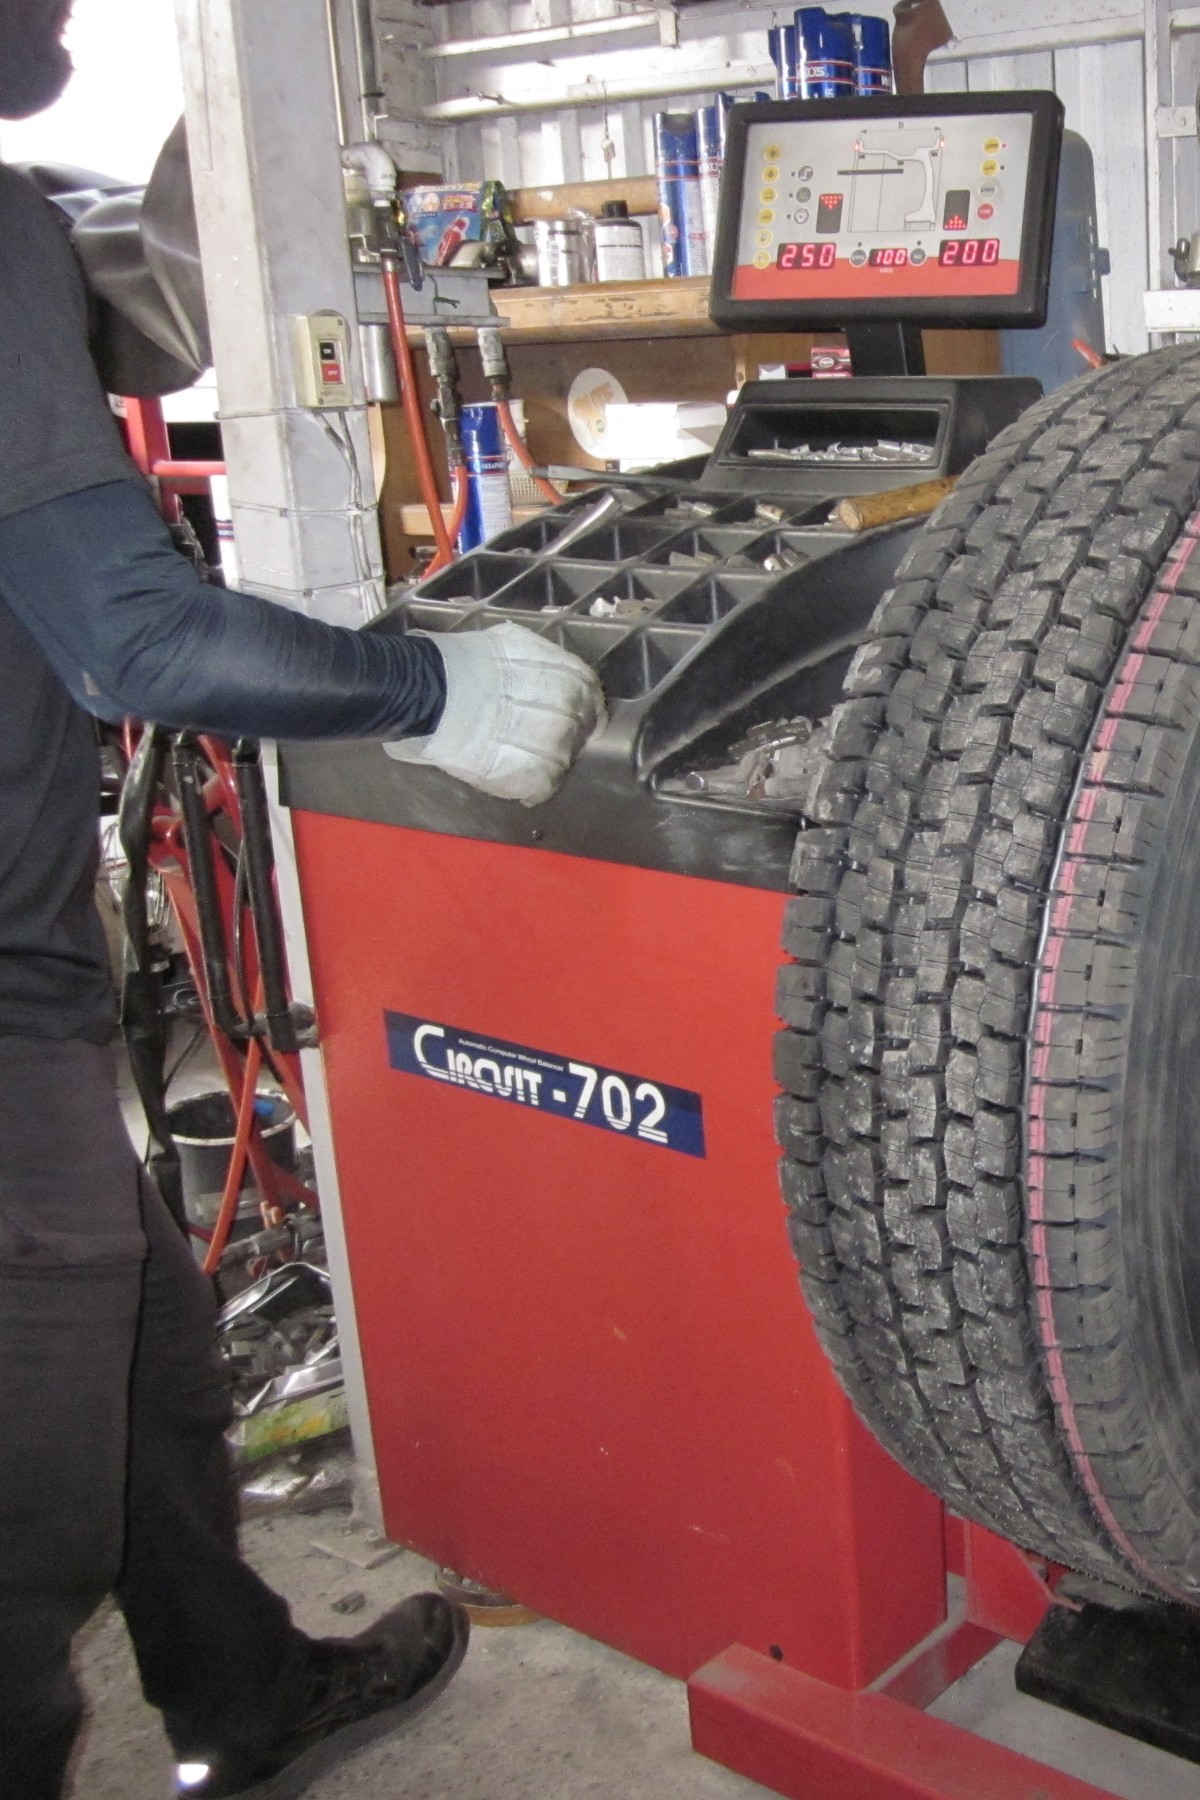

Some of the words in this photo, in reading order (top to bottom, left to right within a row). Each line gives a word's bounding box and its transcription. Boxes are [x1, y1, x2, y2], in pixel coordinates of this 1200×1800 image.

[781, 244, 835, 268] 250
[876, 249, 906, 265] 100
[942, 240, 998, 264] 200
[458, 1038, 487, 1051] Automatic
